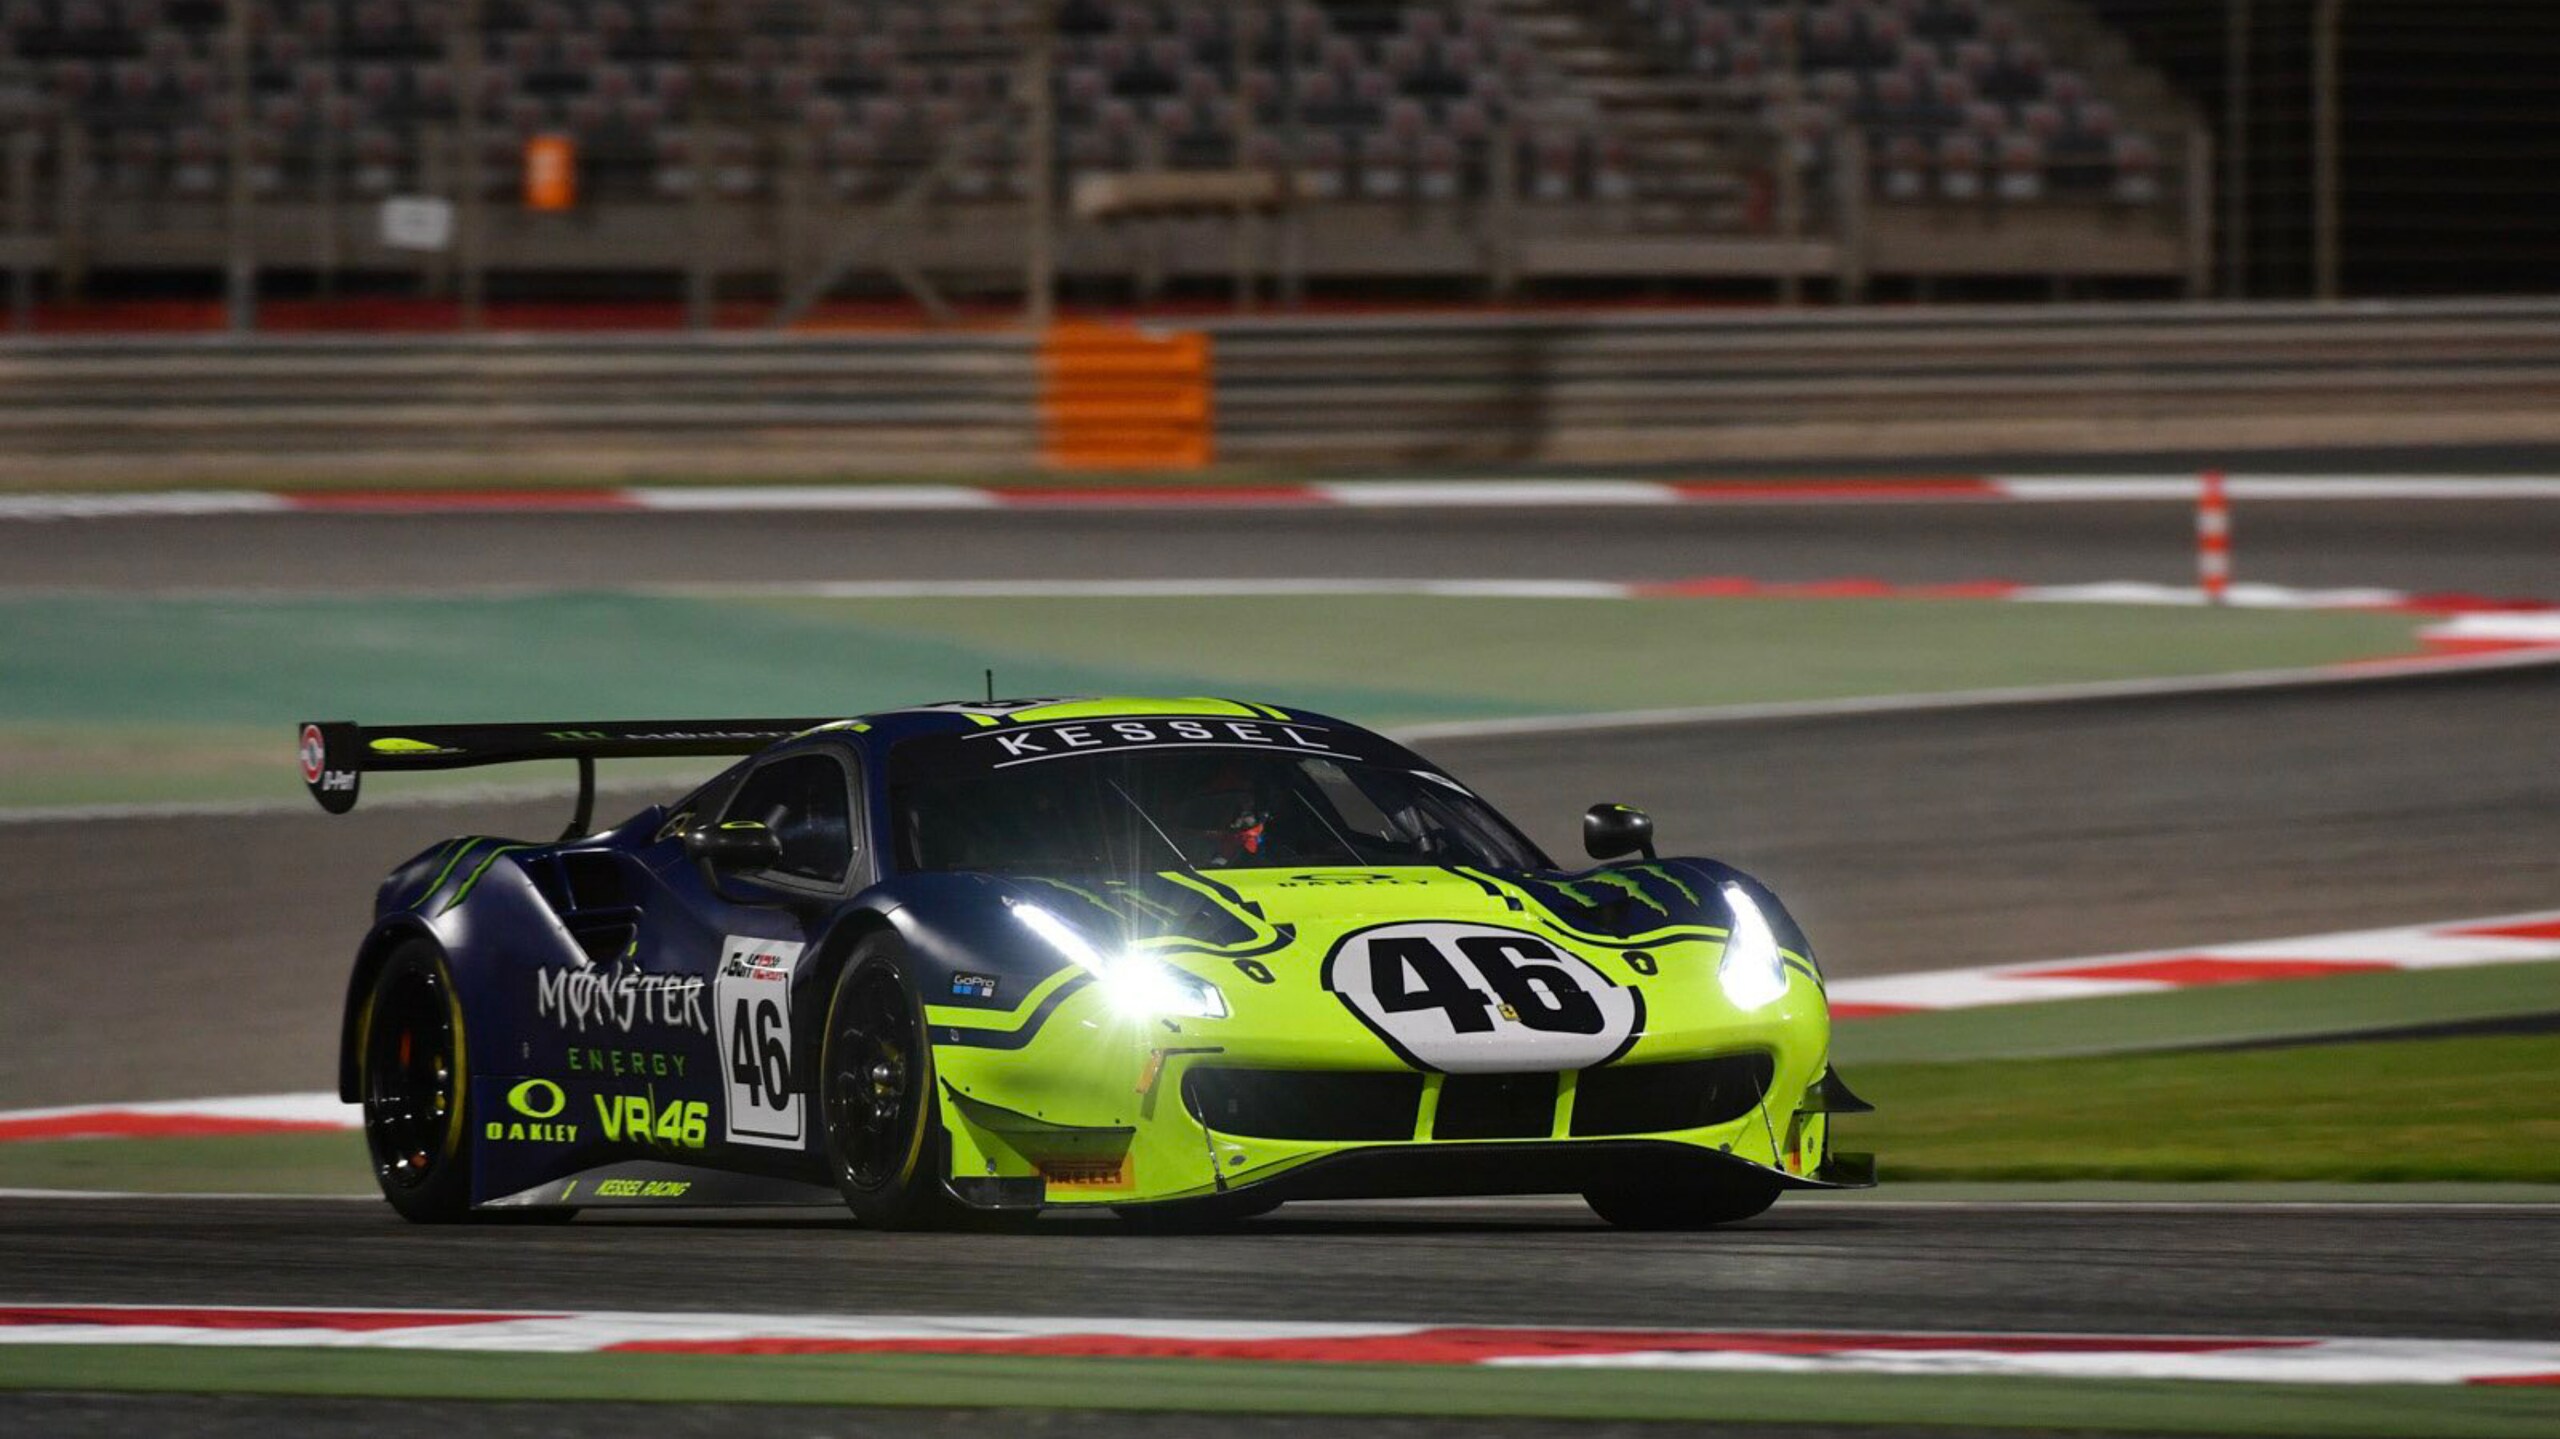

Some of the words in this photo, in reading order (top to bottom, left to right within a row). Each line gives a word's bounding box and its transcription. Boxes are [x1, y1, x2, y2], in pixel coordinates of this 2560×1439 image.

[997, 721, 1330, 756] KESSEL
[954, 974, 995, 987] GoPro
[1367, 936, 1606, 1034] 46
[568, 1047, 685, 1077] ENERGY
[732, 998, 790, 1112] 46
[486, 1122, 577, 1143] OAKLEY
[594, 1094, 709, 1148] VR46
[594, 1179, 646, 1196] KESSEL
[639, 1181, 692, 1196] RACING
